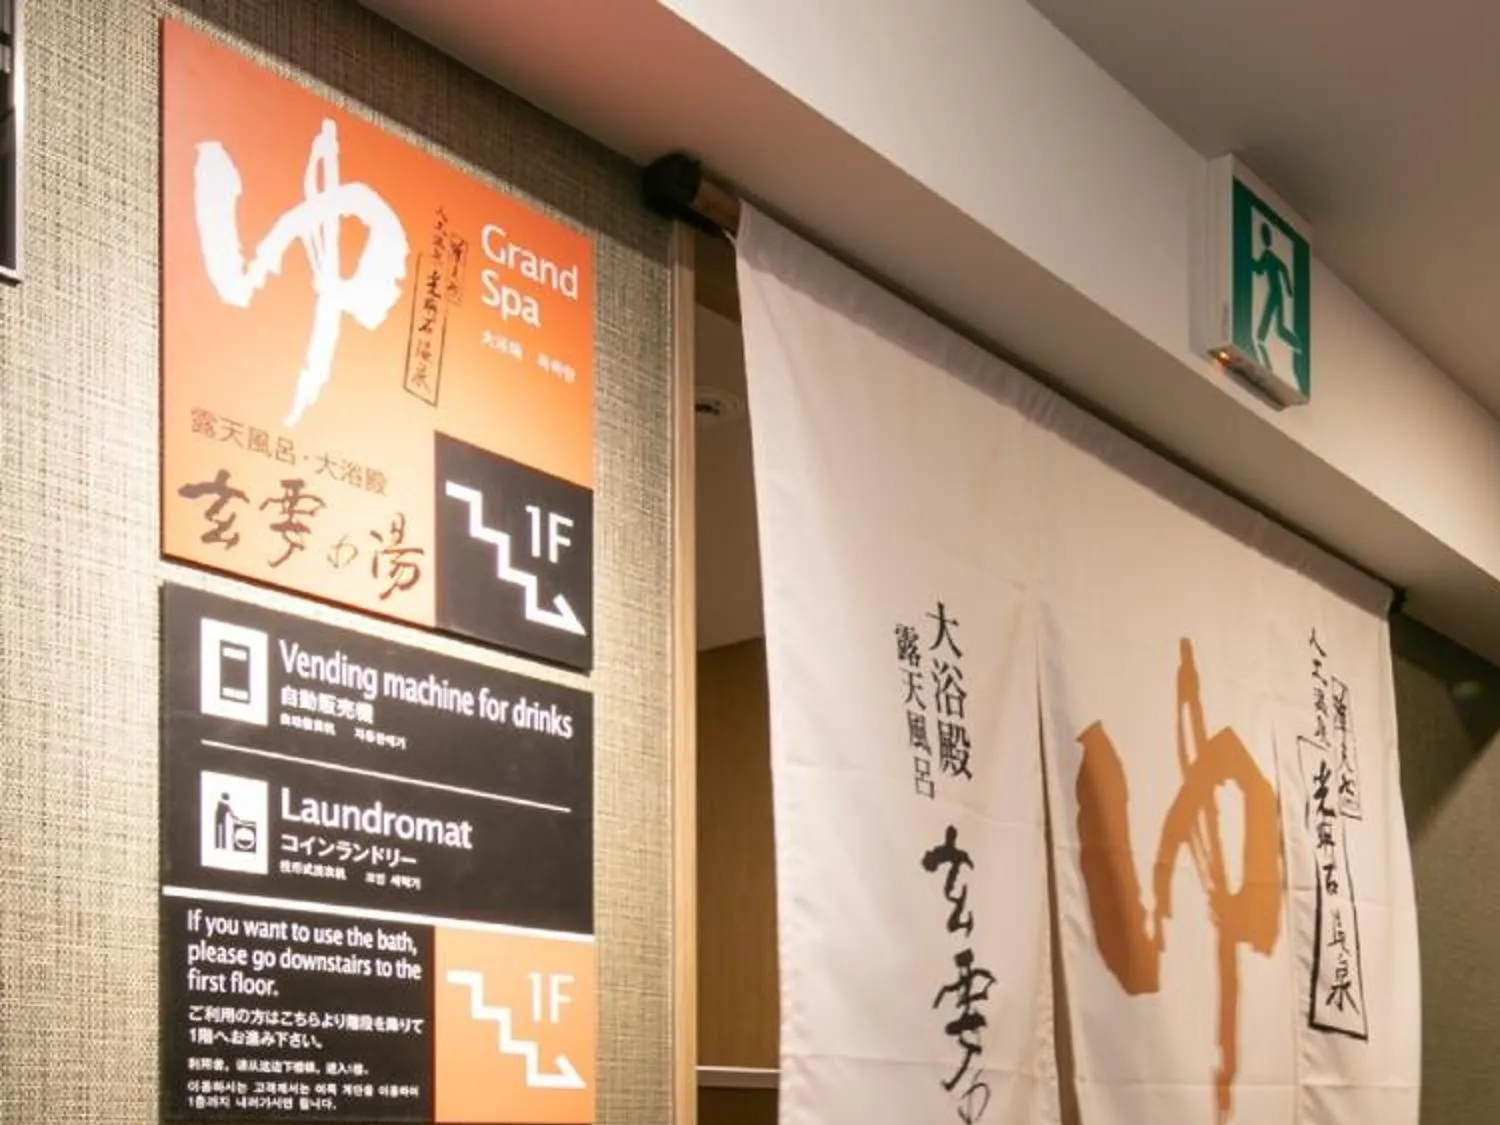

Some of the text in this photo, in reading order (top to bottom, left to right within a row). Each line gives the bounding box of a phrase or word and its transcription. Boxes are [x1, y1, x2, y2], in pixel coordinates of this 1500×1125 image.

[193, 117, 410, 428] ゆ
[481, 224, 579, 301] Grand
[481, 269, 541, 328] Spa
[525, 505, 575, 563] 1F
[278, 639, 574, 740] Vending machine for drinks
[894, 622, 935, 801] 露天風呂
[926, 601, 973, 780] 大浴殿
[281, 787, 473, 850] Laundromat
[281, 834, 417, 868] コインランドリー
[187, 909, 417, 956] If you want to use the bath,
[187, 940, 423, 981] please go downstairs to the
[187, 968, 279, 997] first floor.
[528, 973, 575, 1024] 1F
